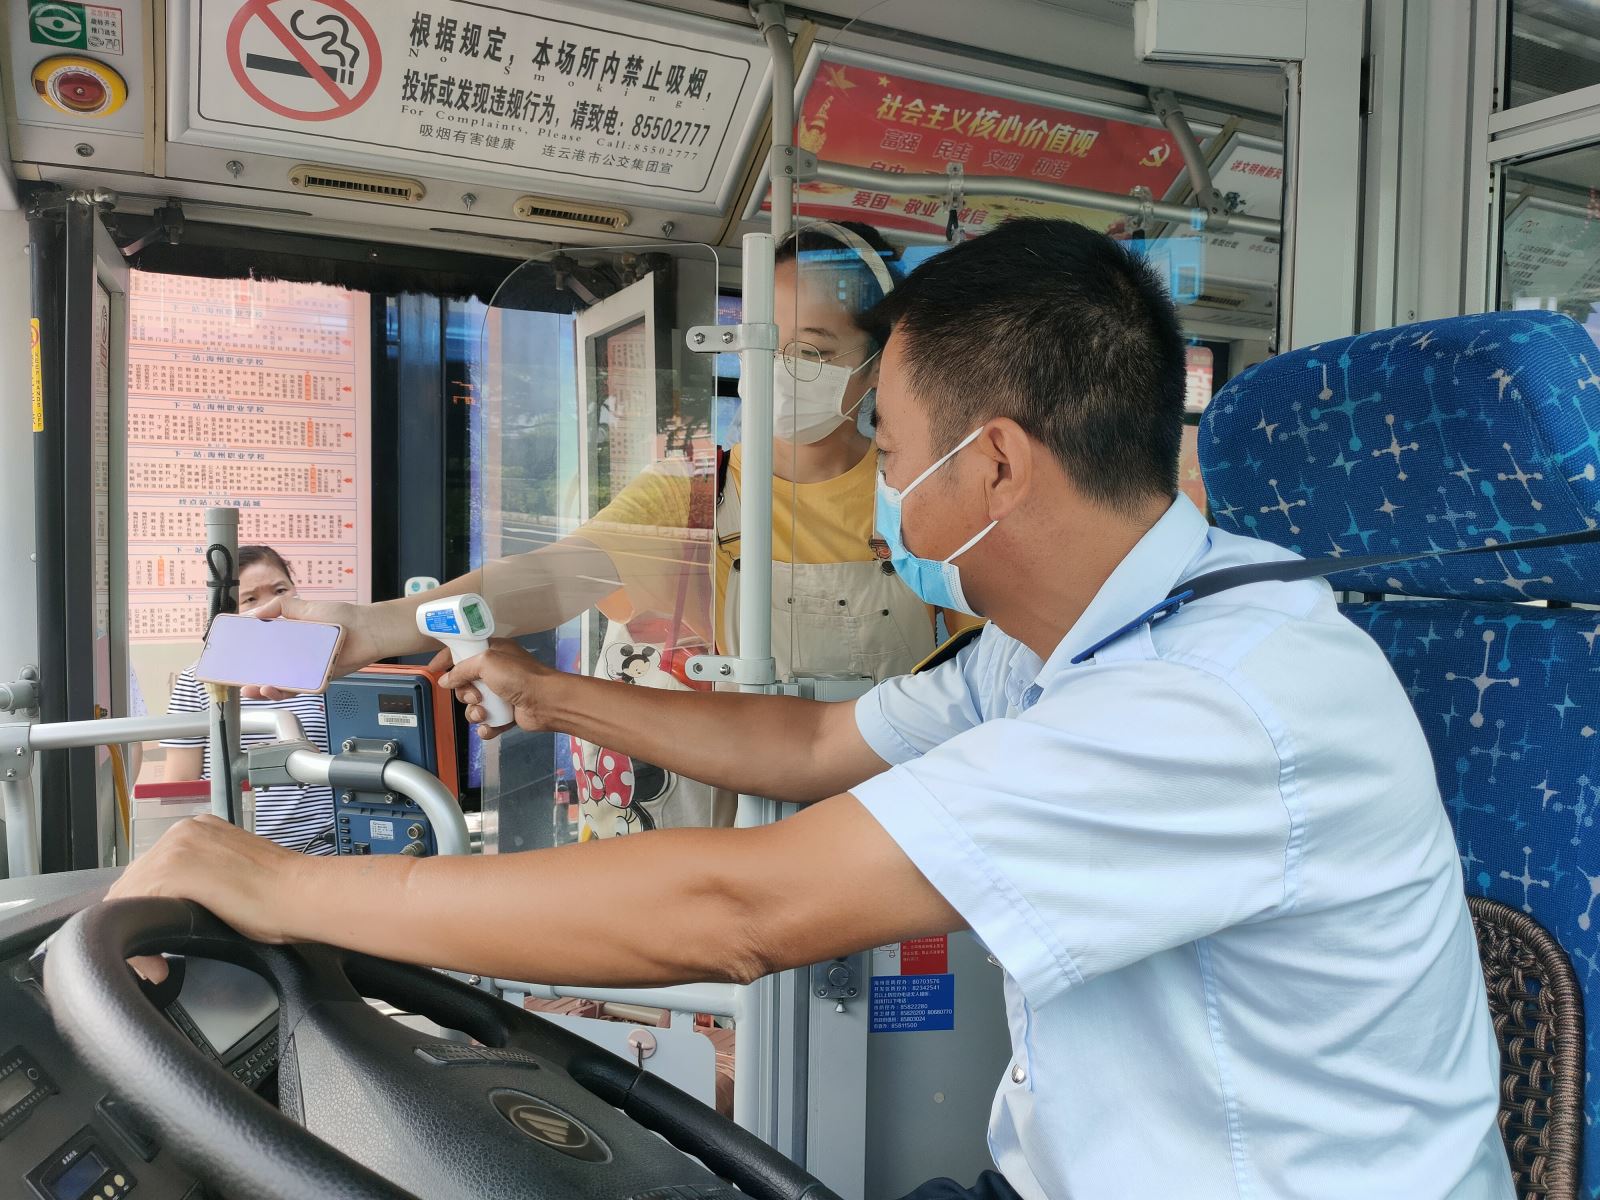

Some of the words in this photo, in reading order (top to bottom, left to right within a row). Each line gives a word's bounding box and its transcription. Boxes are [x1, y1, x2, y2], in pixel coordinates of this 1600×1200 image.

[401, 105, 423, 117] For
[436, 111, 529, 135] Complaints,
[538, 127, 583, 143] Please
[419, 124, 516, 151] 吸烟有害健康
[541, 144, 673, 175] 连云港市公交集团宣
[876, 93, 1100, 158] 社会主义核心价值观
[880, 128, 921, 154] 富强
[933, 139, 972, 163] 民主
[983, 149, 1024, 171] 文明
[1032, 156, 1070, 179] 和谐
[852, 190, 891, 210] 爱国
[903, 198, 940, 218] 敬业
